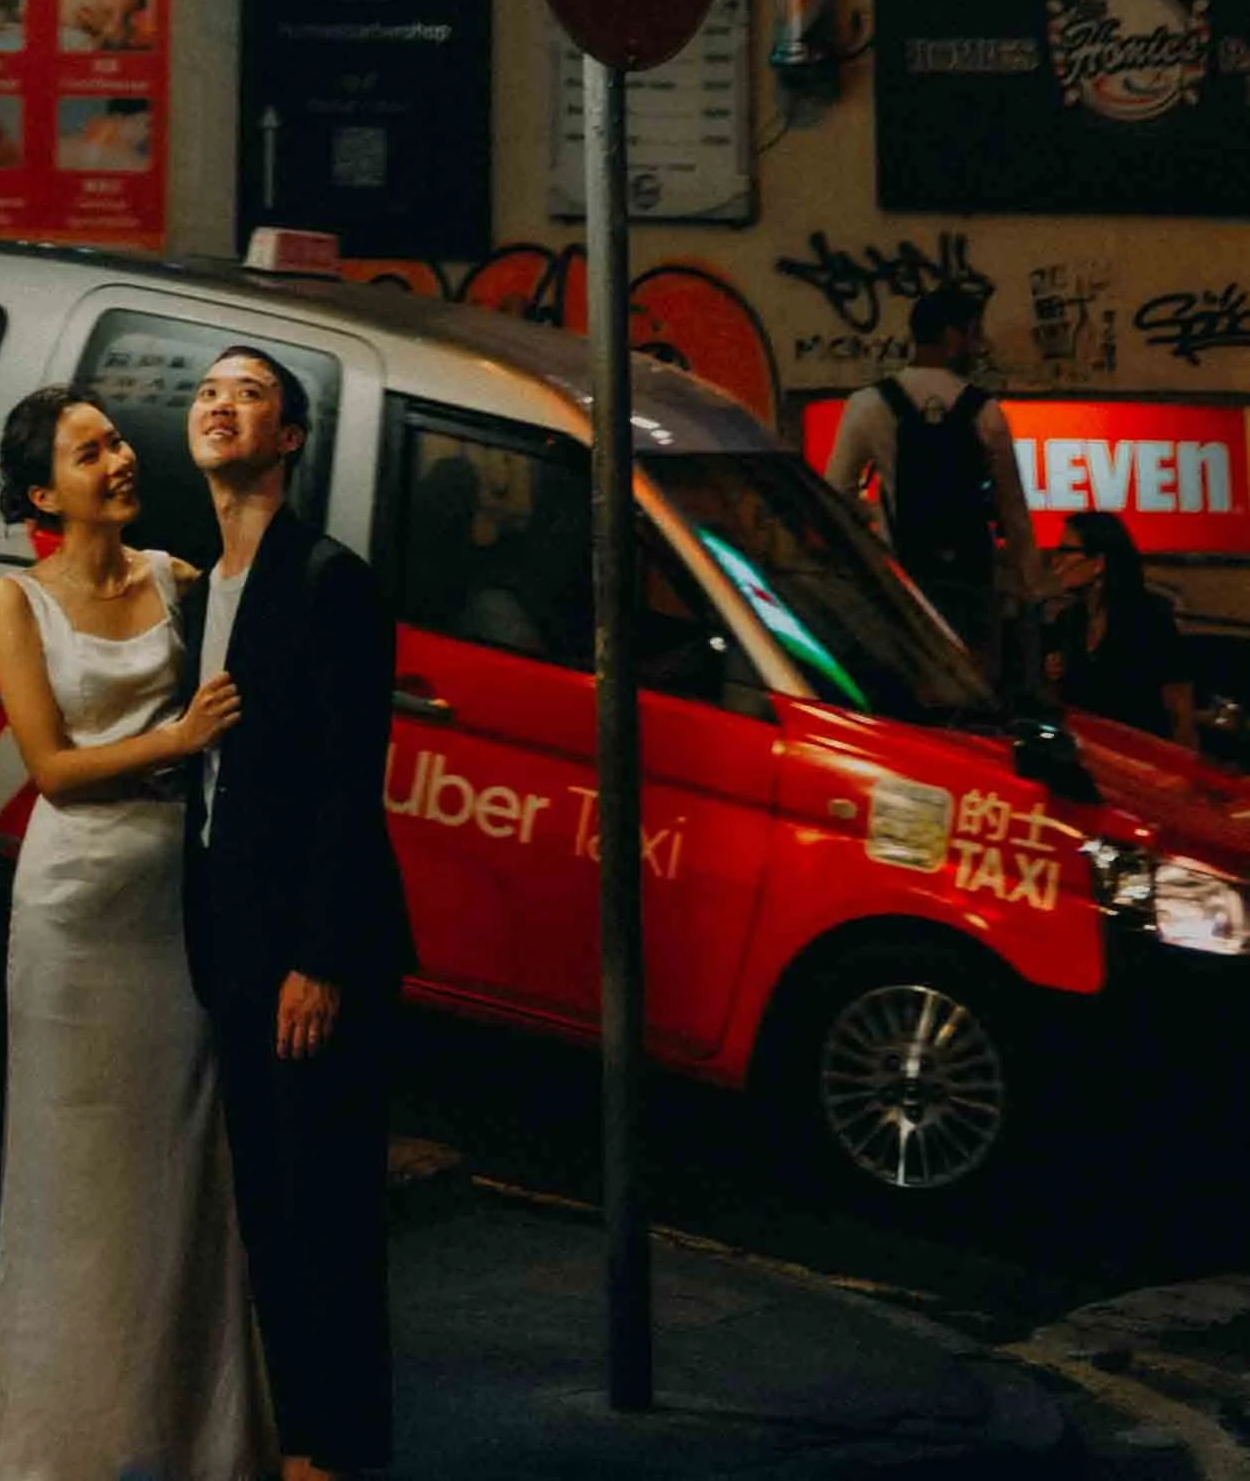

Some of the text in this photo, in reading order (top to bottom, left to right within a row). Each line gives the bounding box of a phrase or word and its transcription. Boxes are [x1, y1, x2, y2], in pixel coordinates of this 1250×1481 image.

[382, 741, 689, 881] Uber Txi
[956, 788, 1059, 852] 的士
[950, 839, 1062, 911] TAXI
